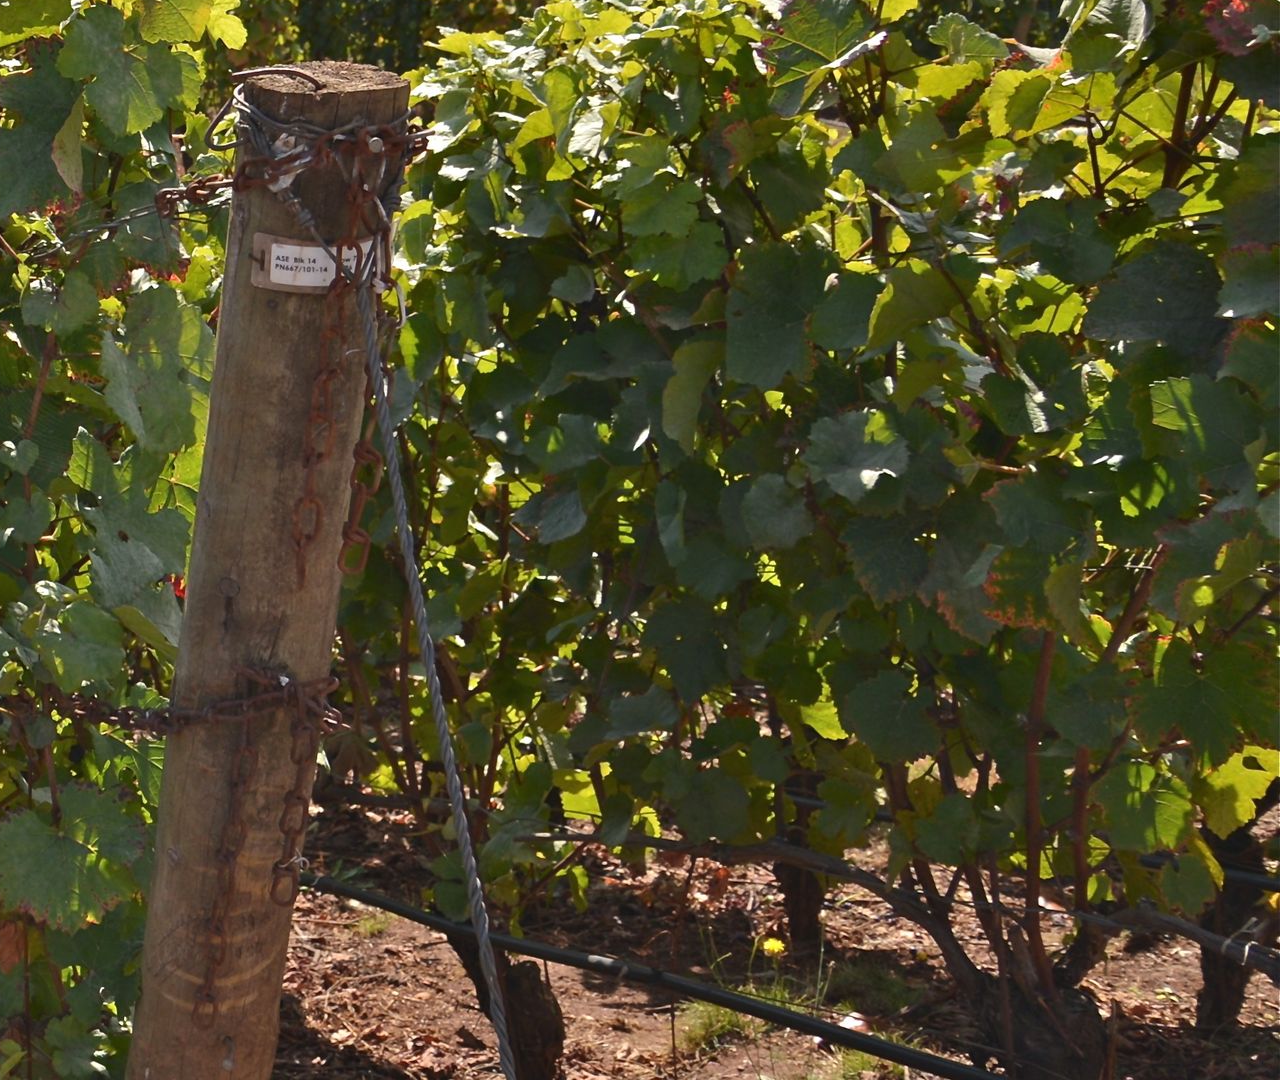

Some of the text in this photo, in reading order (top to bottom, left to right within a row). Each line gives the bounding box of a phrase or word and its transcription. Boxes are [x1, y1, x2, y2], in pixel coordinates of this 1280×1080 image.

[275, 255, 290, 263] ASE
[293, 256, 305, 264] Blk
[307, 257, 317, 265] 14
